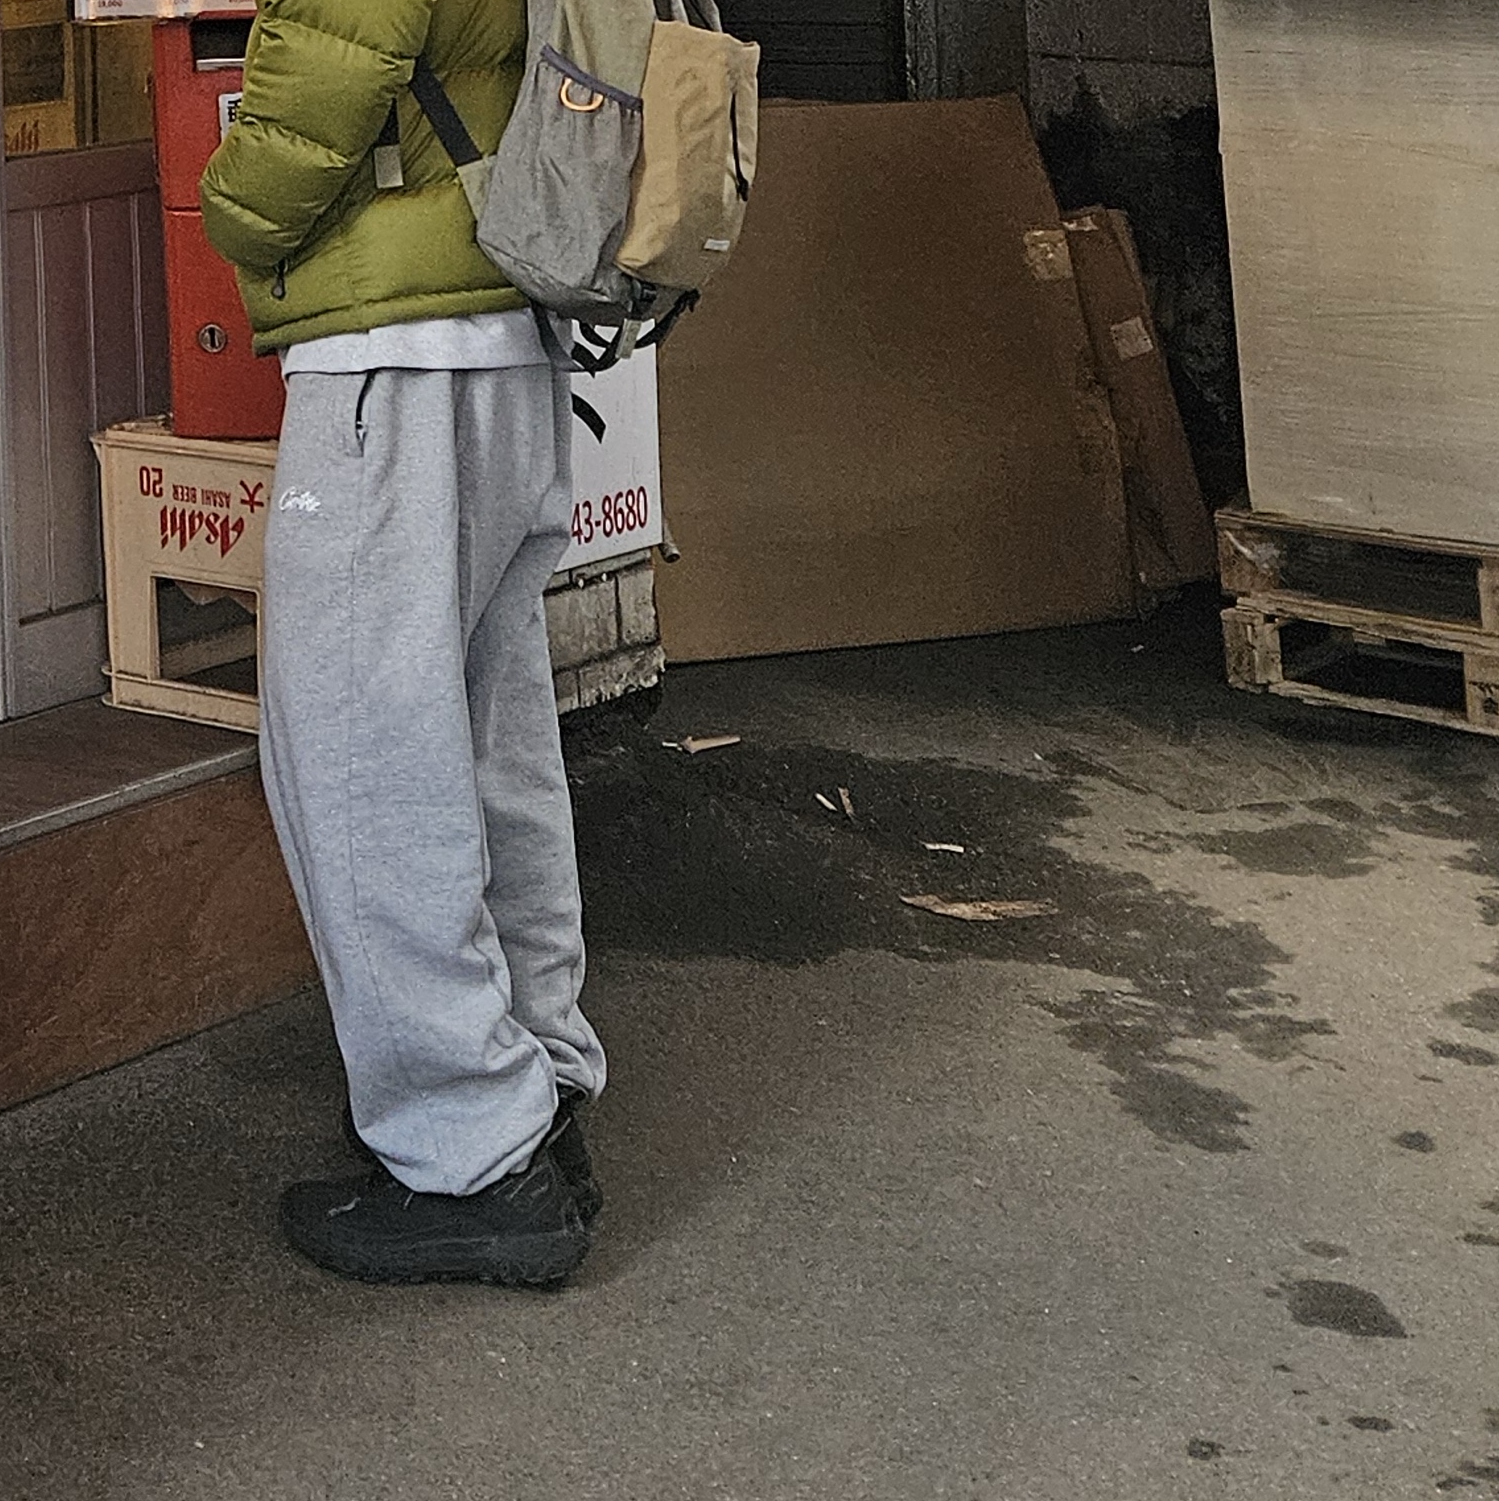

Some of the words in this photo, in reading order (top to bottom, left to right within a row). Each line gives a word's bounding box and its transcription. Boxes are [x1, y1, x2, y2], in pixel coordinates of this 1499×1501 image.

[138, 464, 165, 499] 20
[171, 483, 198, 505] BEER
[200, 487, 233, 510] ASAHI
[238, 478, 266, 515] 大
[159, 504, 246, 560] Asahi
